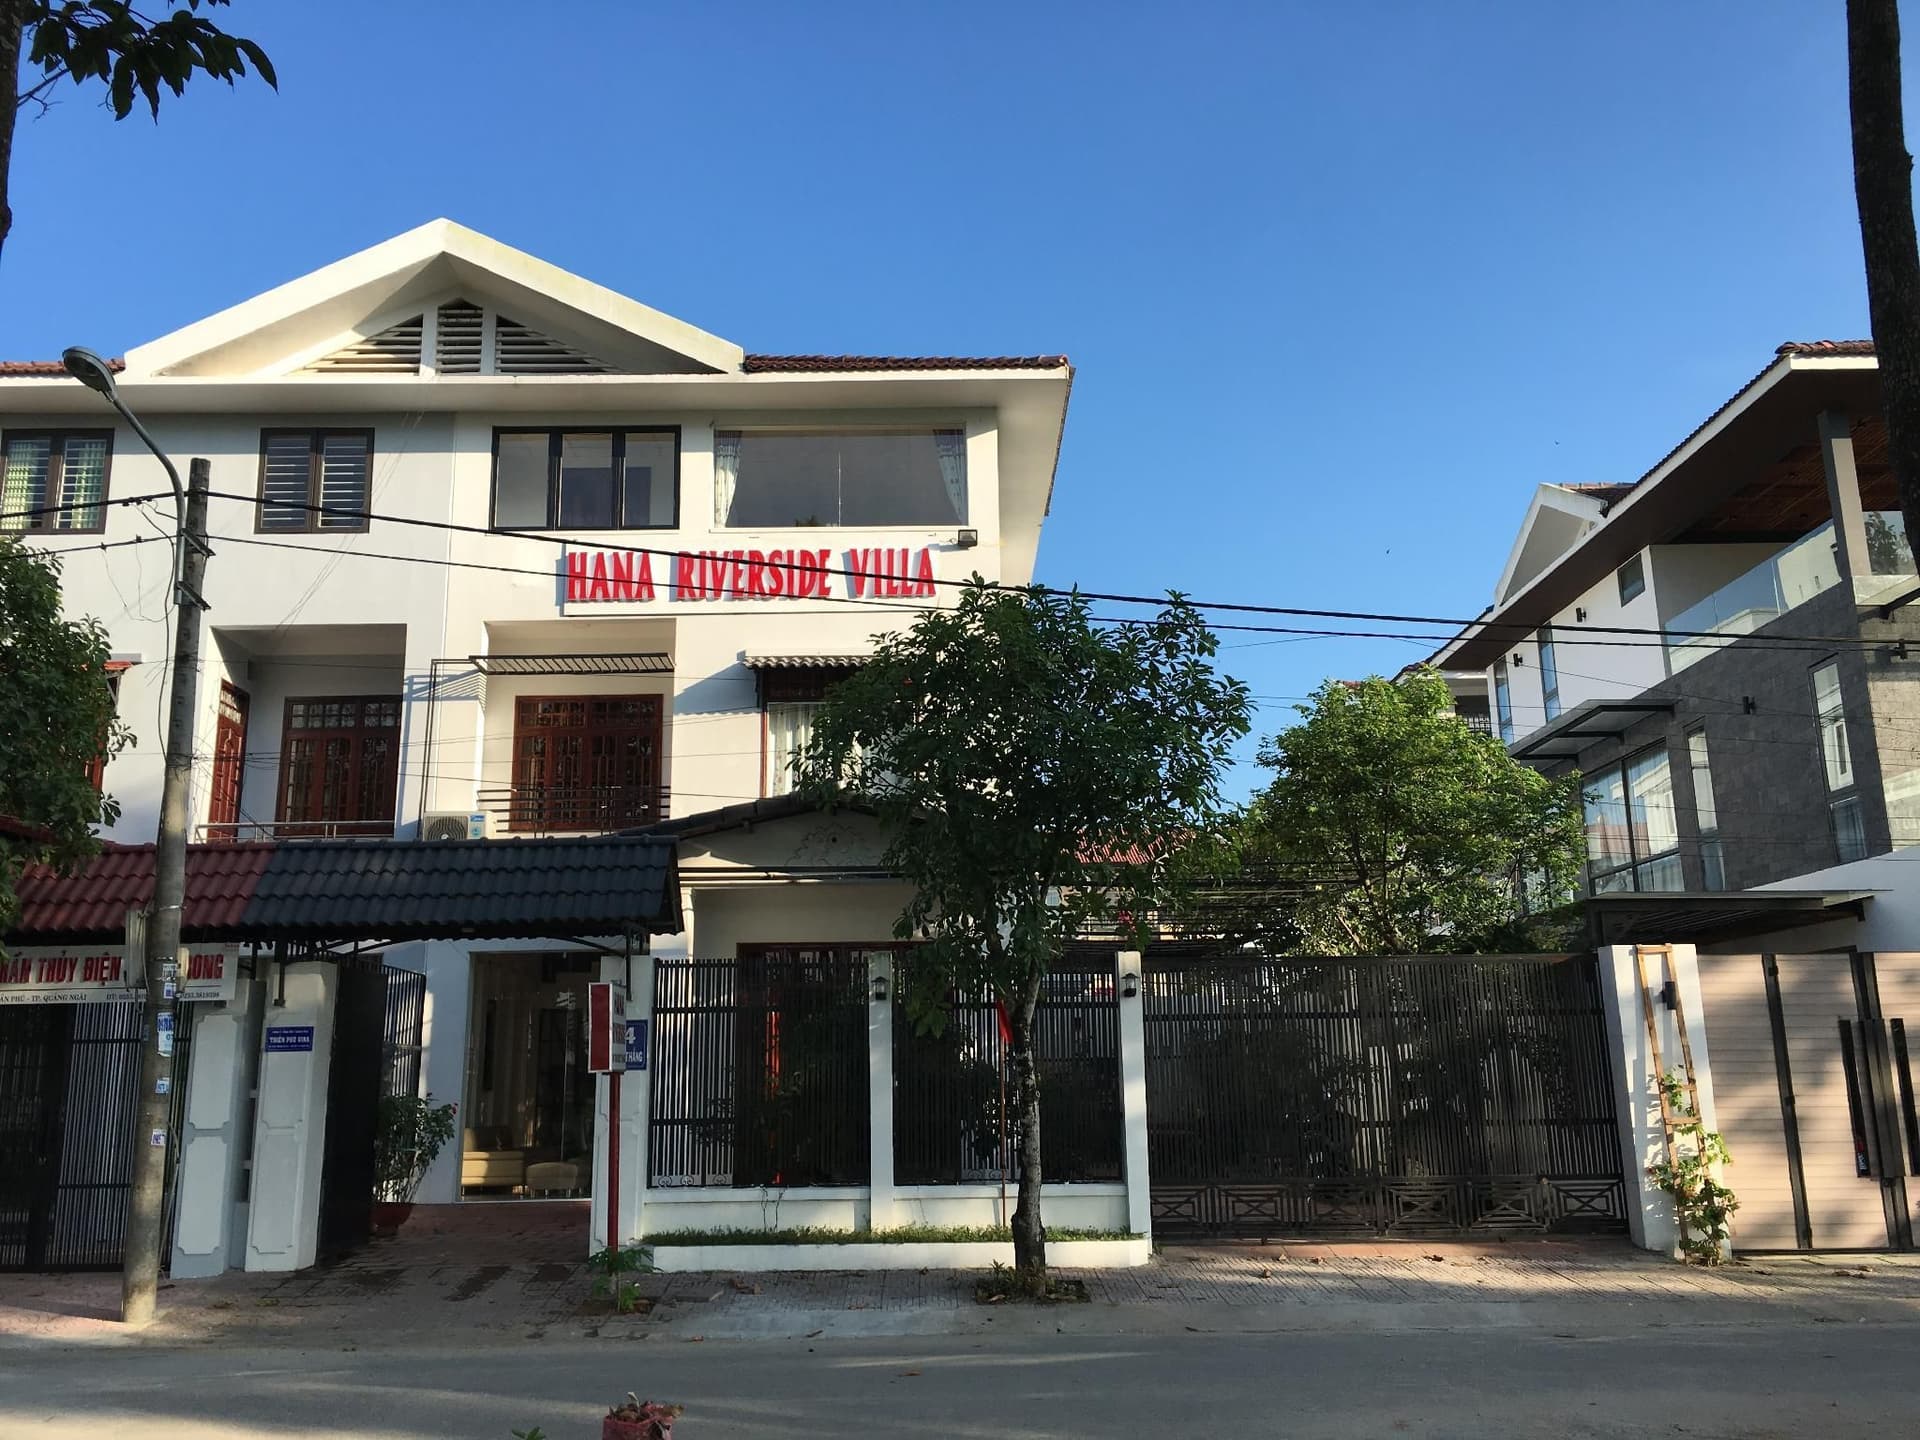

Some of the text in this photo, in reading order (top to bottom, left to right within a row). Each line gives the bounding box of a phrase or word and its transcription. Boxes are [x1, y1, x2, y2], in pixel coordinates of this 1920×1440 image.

[567, 547, 937, 601] HANA RIVERSIDE VILLA
